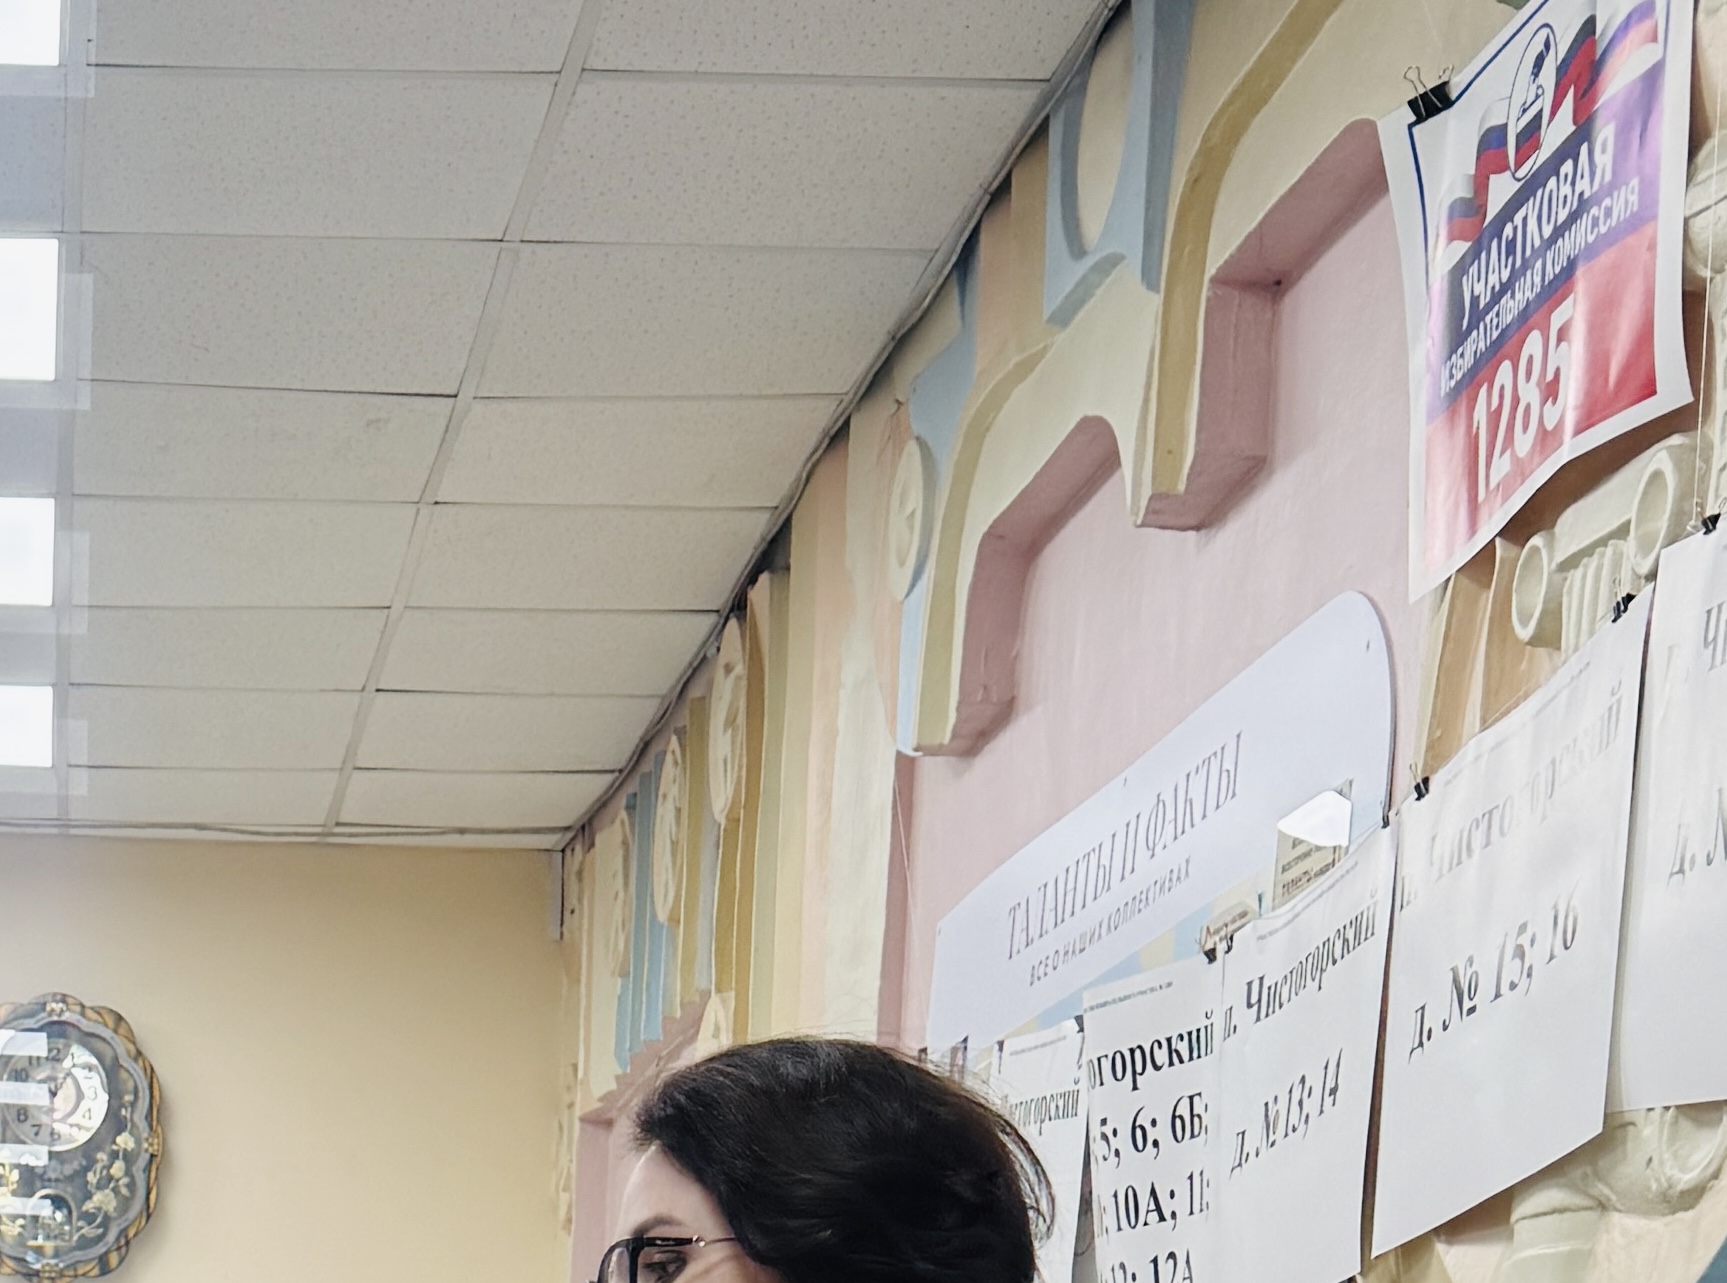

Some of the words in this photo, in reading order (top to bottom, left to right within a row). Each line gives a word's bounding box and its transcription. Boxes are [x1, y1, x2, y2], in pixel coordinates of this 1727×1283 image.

[1440, 258, 1543, 398] ИЗБИРАТЕЛЬНАЯ
[1544, 175, 1640, 286] КОМИССИЯ
[1461, 122, 1616, 332] УЧАСТКОВАЯ
[1473, 292, 1575, 505] 1285
[1008, 831, 1118, 961] ТАЛАНТЫ
[1145, 729, 1243, 860] ФАКТЫ
[1429, 678, 1623, 884] Чистоорский
[1029, 955, 1050, 988] ВСЕ
[1062, 918, 1104, 966] НАШИХ
[1105, 854, 1192, 937] КОЛЛЕКТИВАХ
[1245, 887, 1379, 1025] Чистогорский
[1408, 1002, 1433, 1065] д.
[1545, 876, 1582, 965] 16
[1111, 1180, 1178, 1232] 10А;
[1130, 1106, 1161, 1160] 6;
